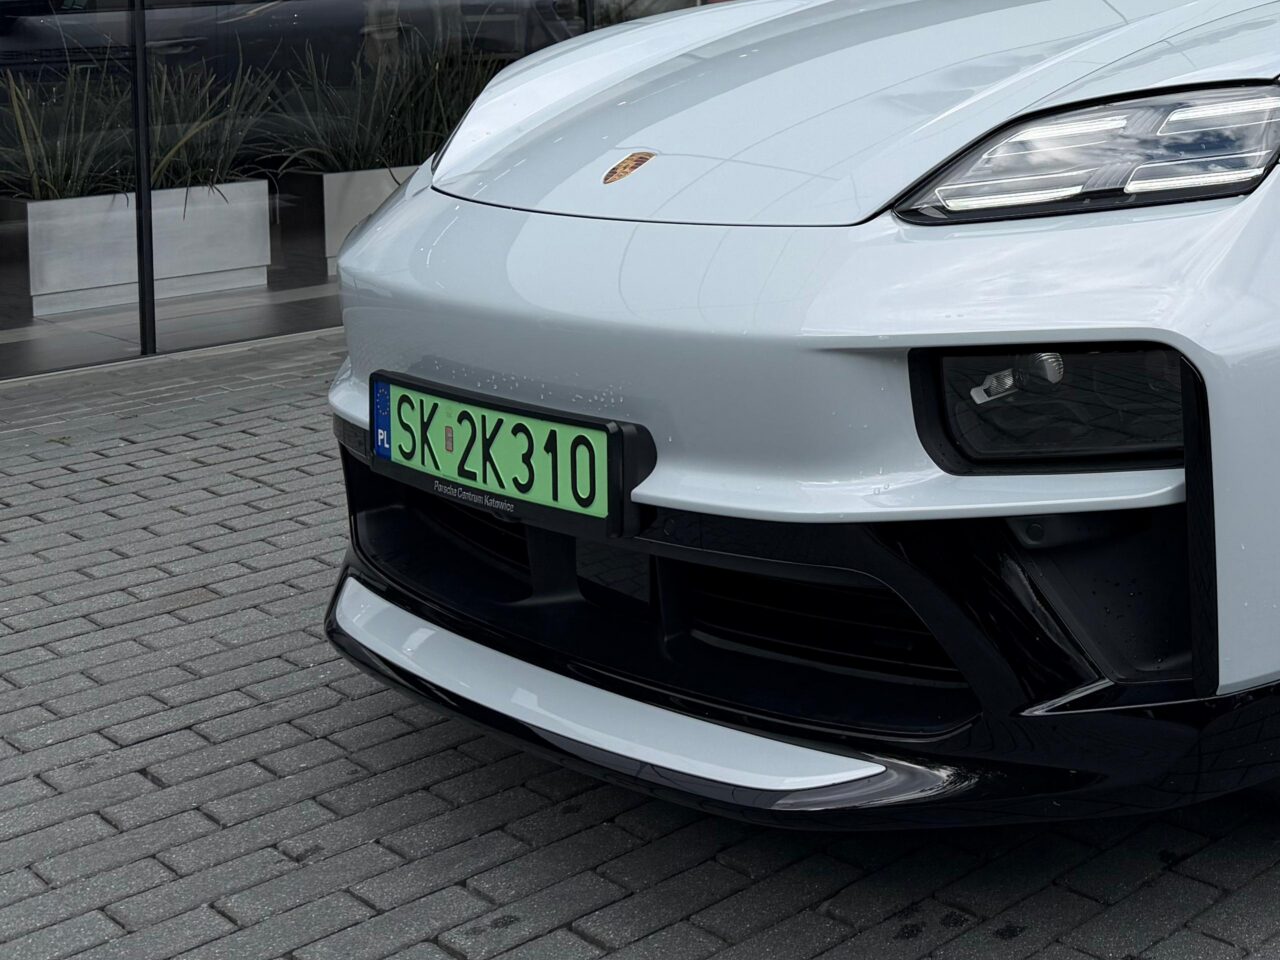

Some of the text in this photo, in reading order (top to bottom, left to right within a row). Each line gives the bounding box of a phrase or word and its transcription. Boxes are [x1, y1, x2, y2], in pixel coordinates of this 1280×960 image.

[378, 429, 389, 448] PL
[397, 394, 596, 508] SK 2K310
[433, 480, 515, 512] Porsche Centrum Katowice
